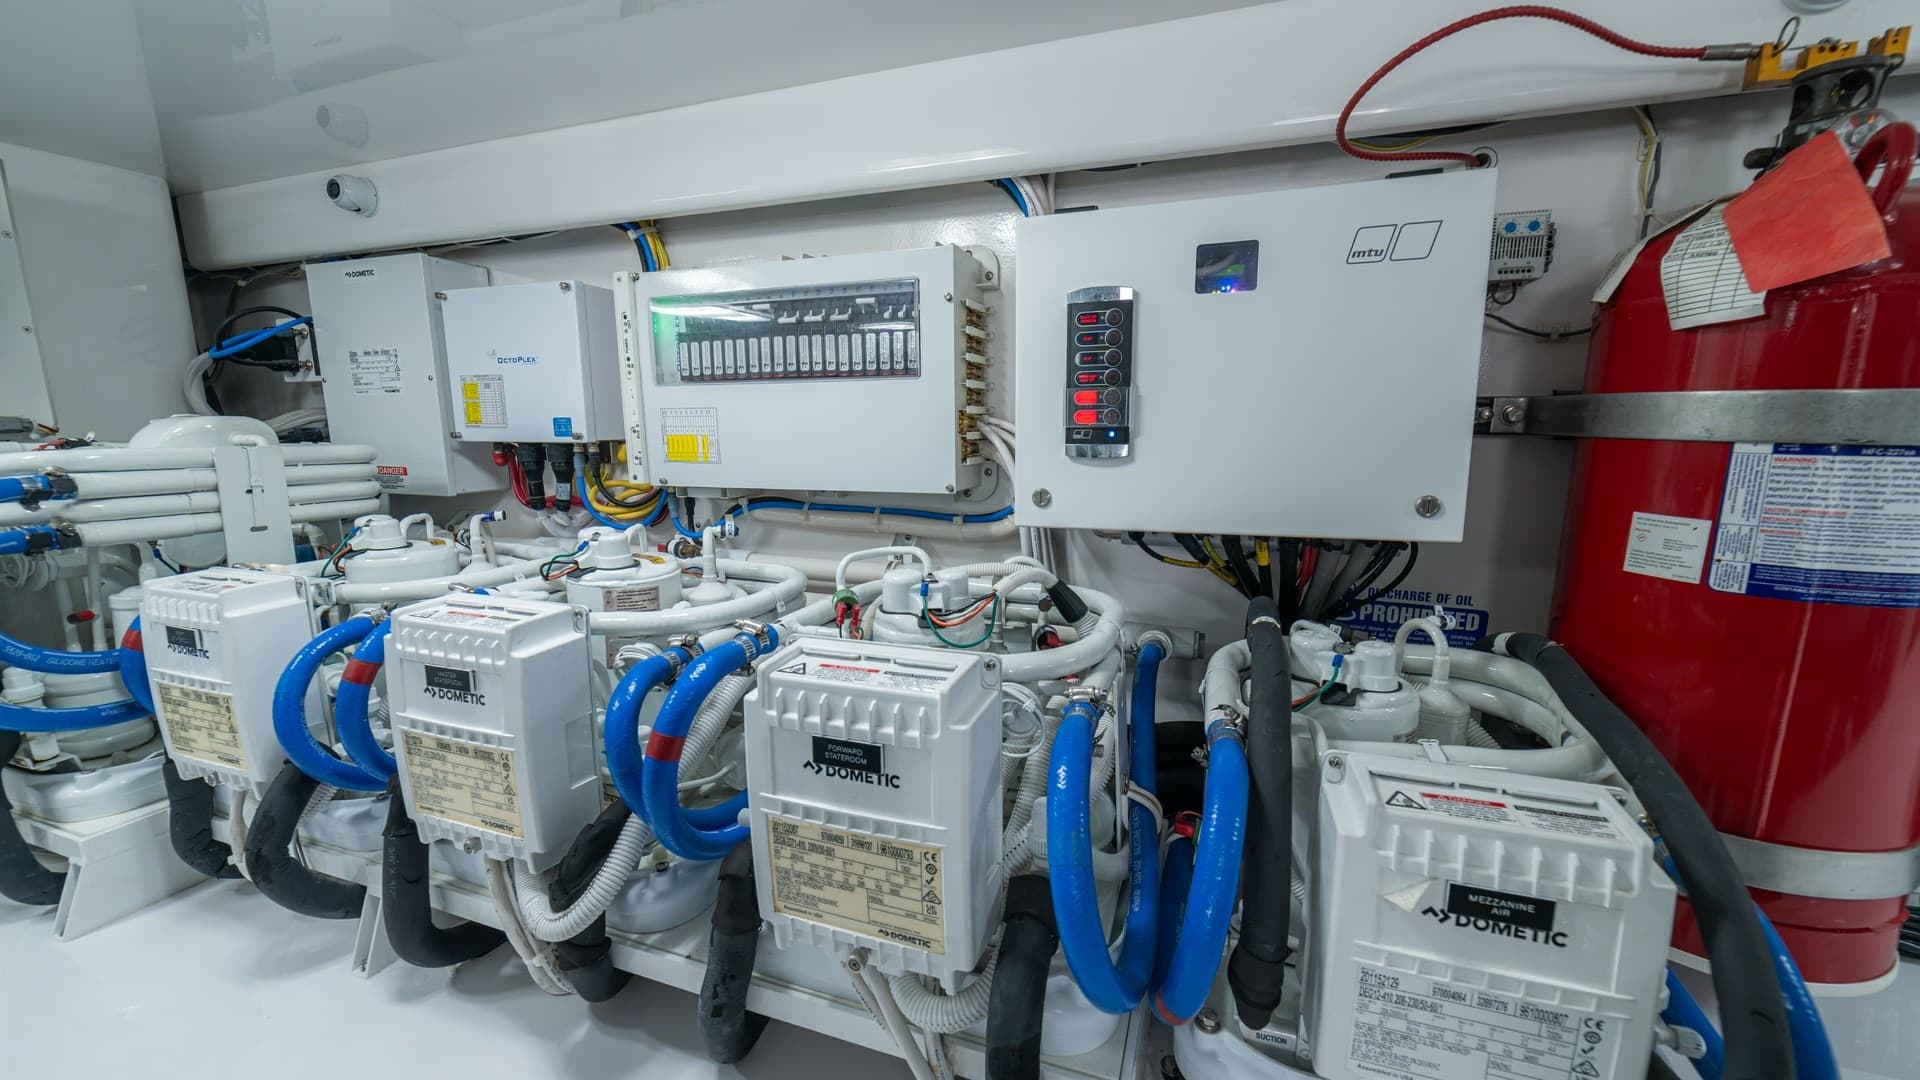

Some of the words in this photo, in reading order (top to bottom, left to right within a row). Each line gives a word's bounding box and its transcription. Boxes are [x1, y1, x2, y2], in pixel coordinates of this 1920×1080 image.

[1352, 248, 1384, 258] mtu
[1368, 587, 1432, 603] DICHARGE
[1436, 593, 1451, 604] OF
[1455, 595, 1474, 606] OIL
[1359, 604, 1480, 632] PROHIBED
[178, 644, 210, 659] DOMETIC
[47, 656, 86, 666] SILICONE
[438, 688, 486, 706] DOMETIC
[824, 752, 868, 765] STATEROOM
[828, 744, 864, 756] FORWARD
[825, 765, 901, 789] DOMETIC
[1468, 893, 1536, 913] MEZZANINE
[1491, 908, 1511, 917] AIR
[890, 931, 932, 949] DOMETIC
[1455, 915, 1569, 948] DOMETIC
[1361, 970, 1400, 989] 201152129
[1256, 1032, 1287, 1045] SUCTION
